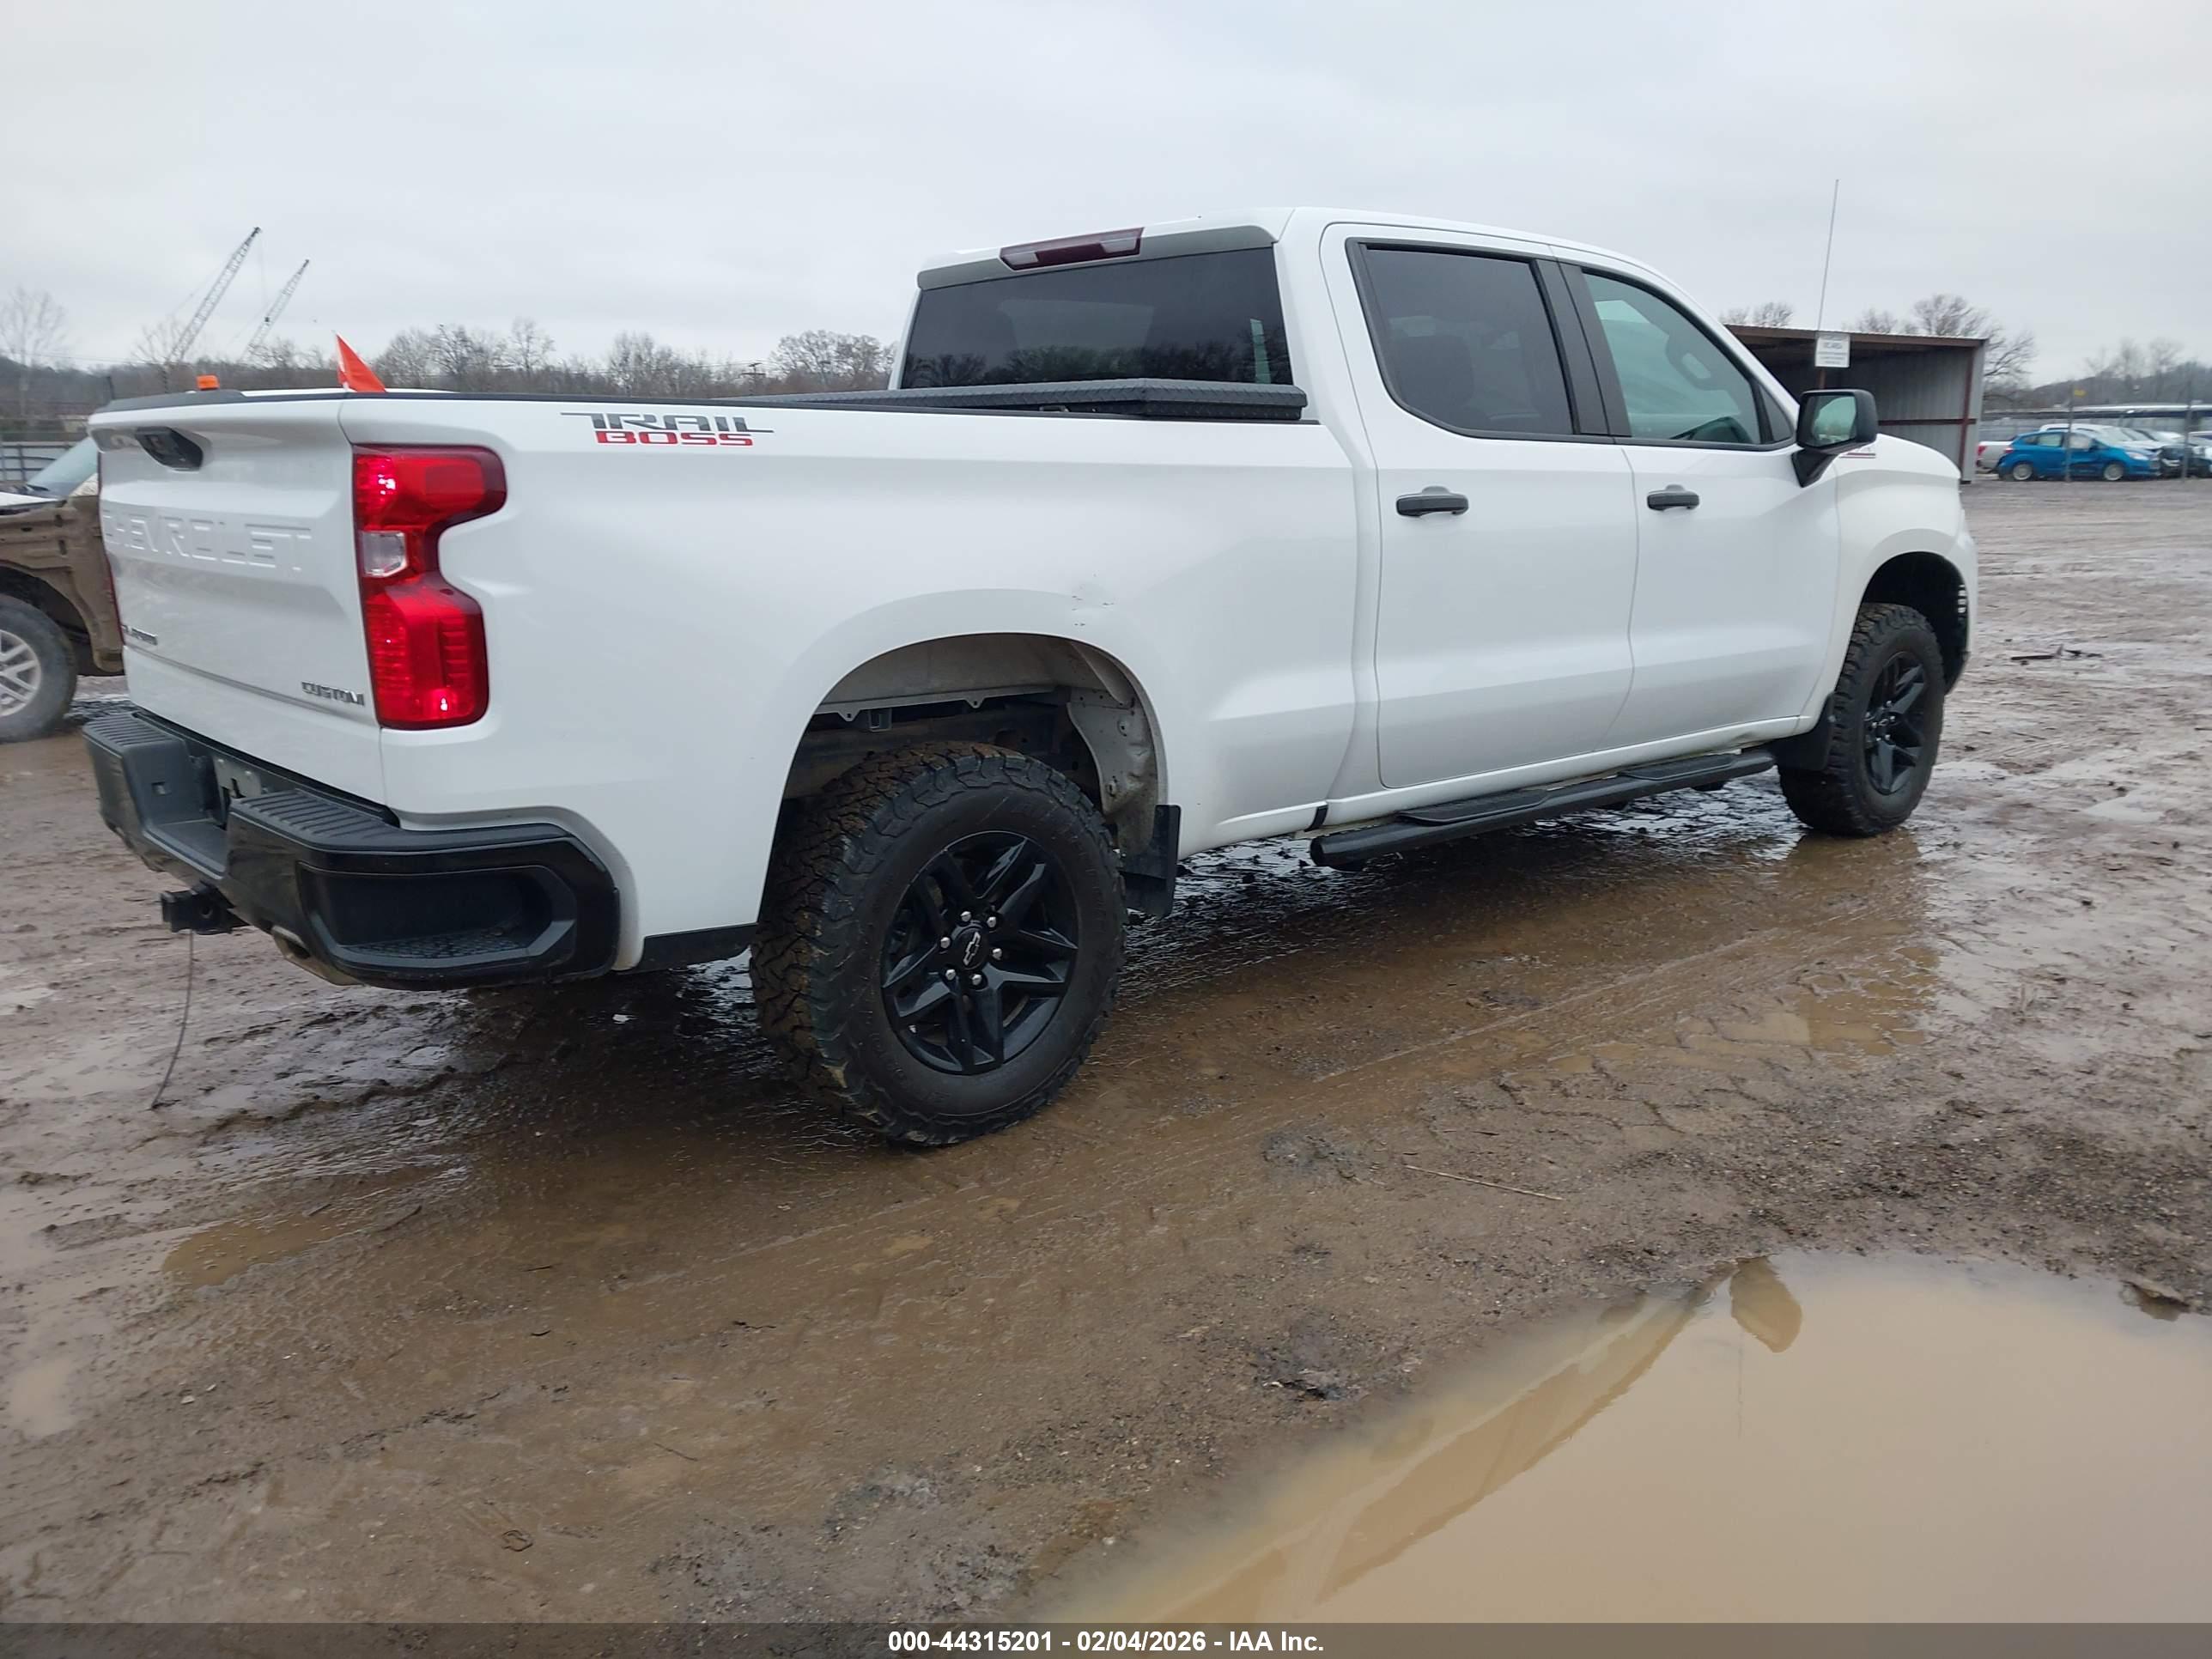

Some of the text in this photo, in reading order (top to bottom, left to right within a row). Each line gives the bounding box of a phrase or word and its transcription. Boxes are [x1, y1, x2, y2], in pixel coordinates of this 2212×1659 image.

[561, 412, 775, 433] TRAIL
[595, 430, 753, 447] BOSS
[301, 681, 365, 706] CUSTOM
